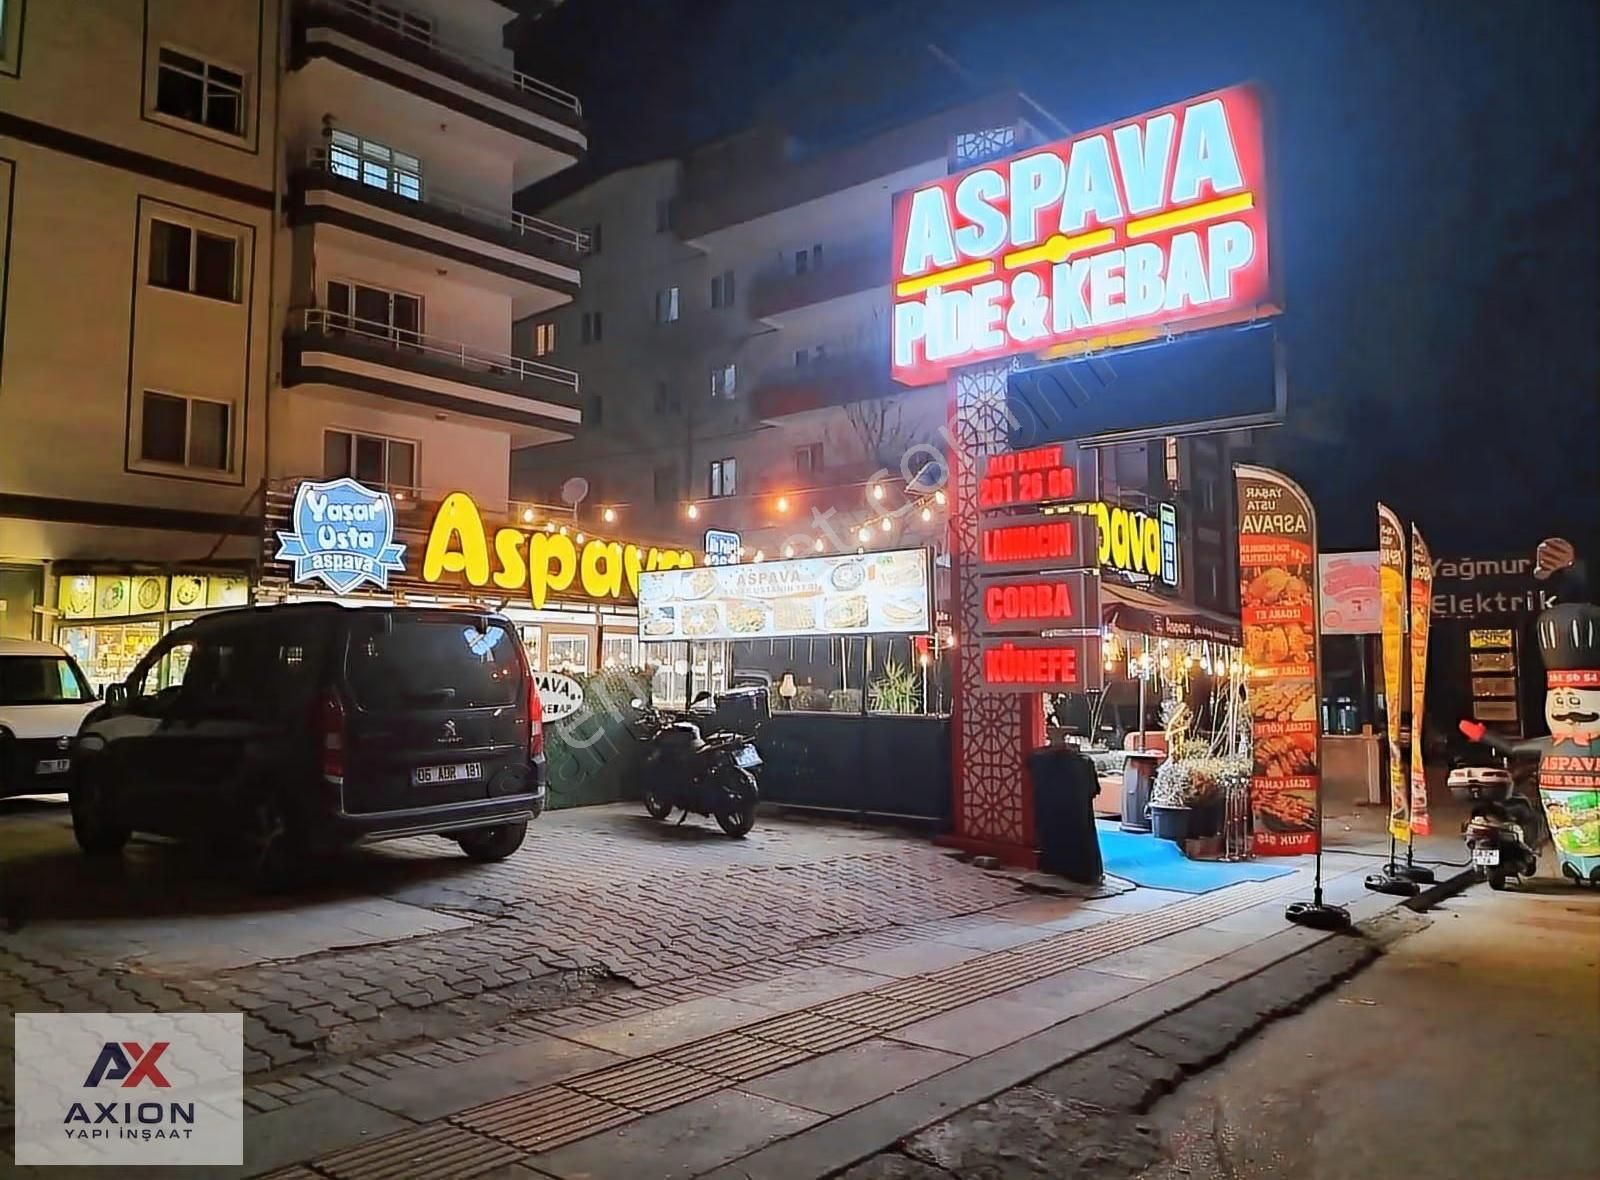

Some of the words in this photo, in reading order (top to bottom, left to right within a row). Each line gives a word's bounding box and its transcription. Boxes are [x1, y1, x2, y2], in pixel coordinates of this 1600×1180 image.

[902, 98, 1244, 276] ASPAVA
[306, 490, 383, 525] Yaşar
[318, 525, 374, 549] Usta
[312, 554, 374, 573] aspava
[1431, 558, 1531, 580] Yağmur
[737, 570, 801, 586] ASPAVA
[986, 583, 1072, 624] ÇORBA
[1431, 590, 1557, 614] Elektrik
